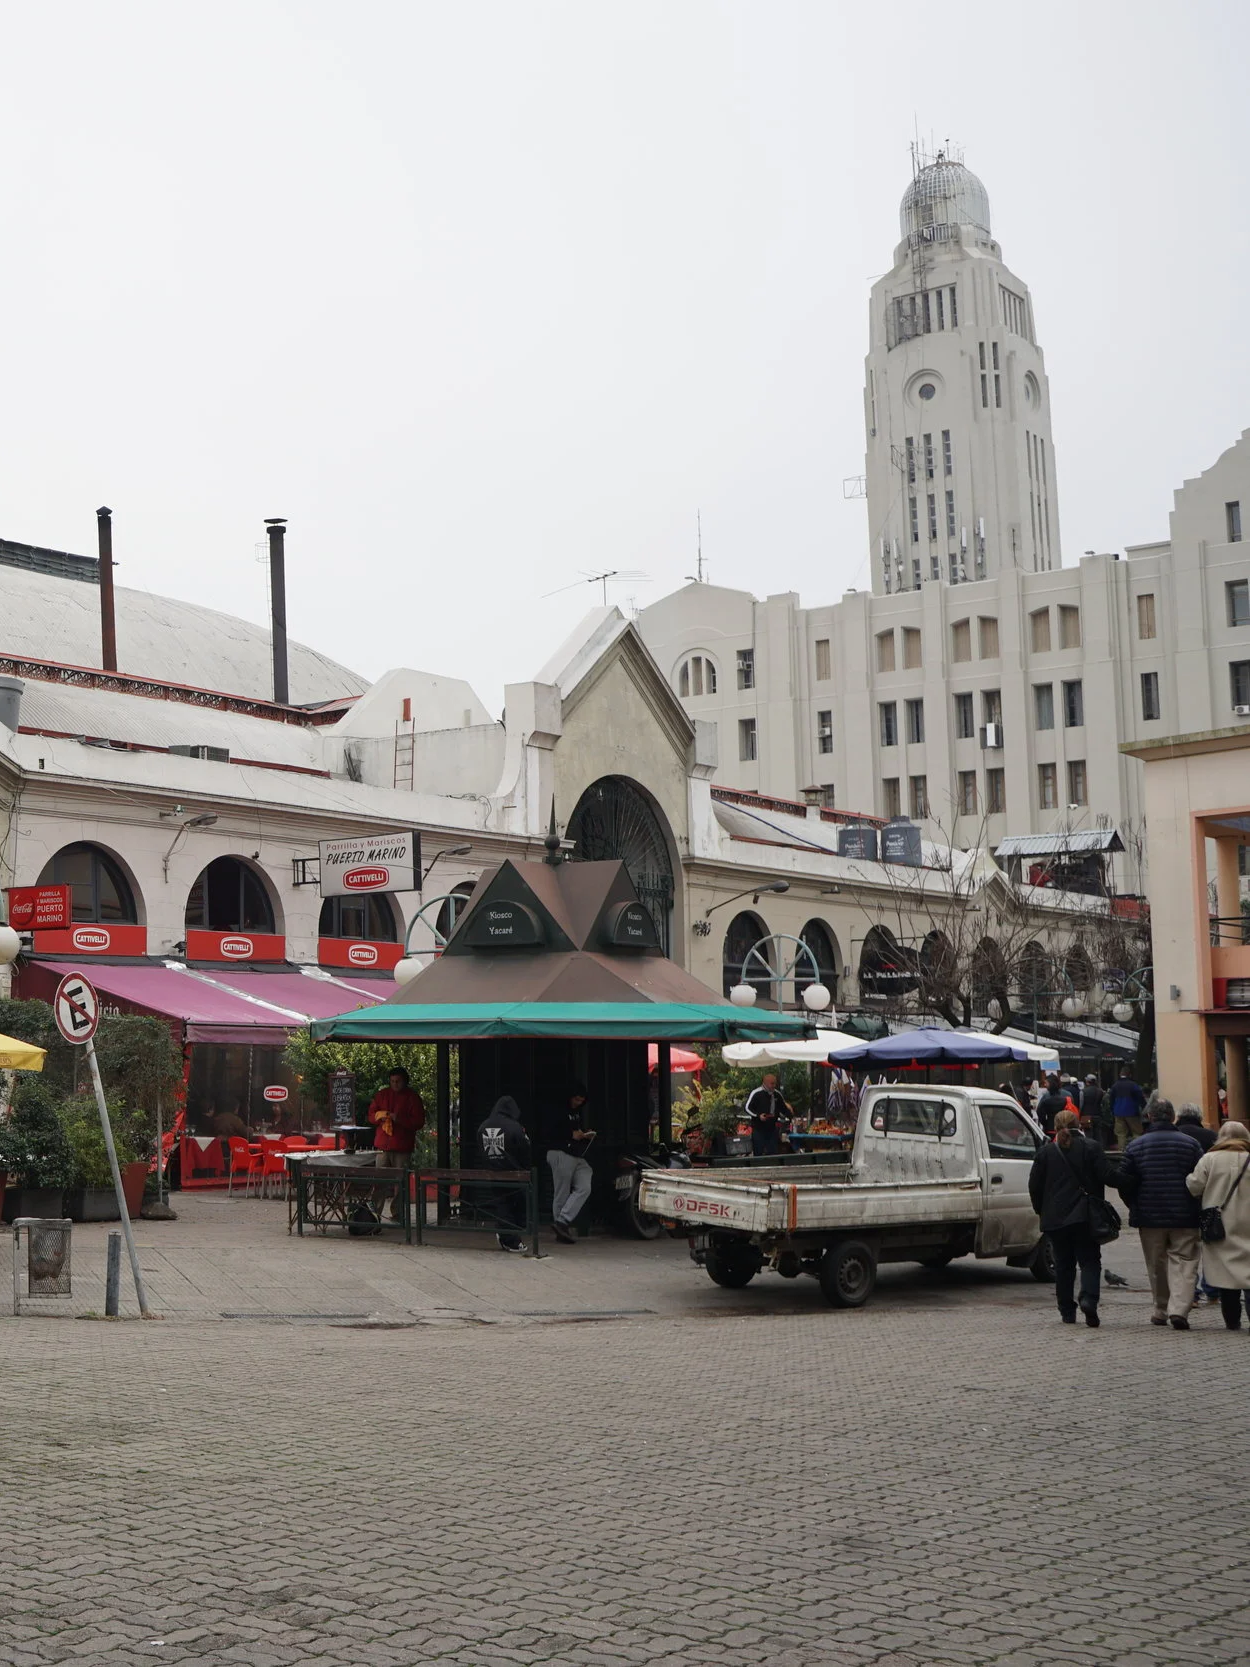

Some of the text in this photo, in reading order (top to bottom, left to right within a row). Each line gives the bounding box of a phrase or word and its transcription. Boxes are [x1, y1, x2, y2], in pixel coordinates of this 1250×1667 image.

[326, 842, 358, 851] Parrilla
[367, 837, 406, 847] Mariscos
[326, 846, 406, 865] PUERTO MARINO
[348, 873, 384, 883] CATTIVELLI
[37, 904, 64, 912] PUERTO
[37, 914, 63, 922] MARINO
[489, 911, 513, 919] Kiosco
[489, 925, 513, 935] Yacaré
[76, 935, 106, 943] CATTIVELLI
[223, 943, 249, 951] CATTIVELLI
[351, 950, 374, 958] CATTIVELLI
[686, 1199, 731, 1217] DFSK
